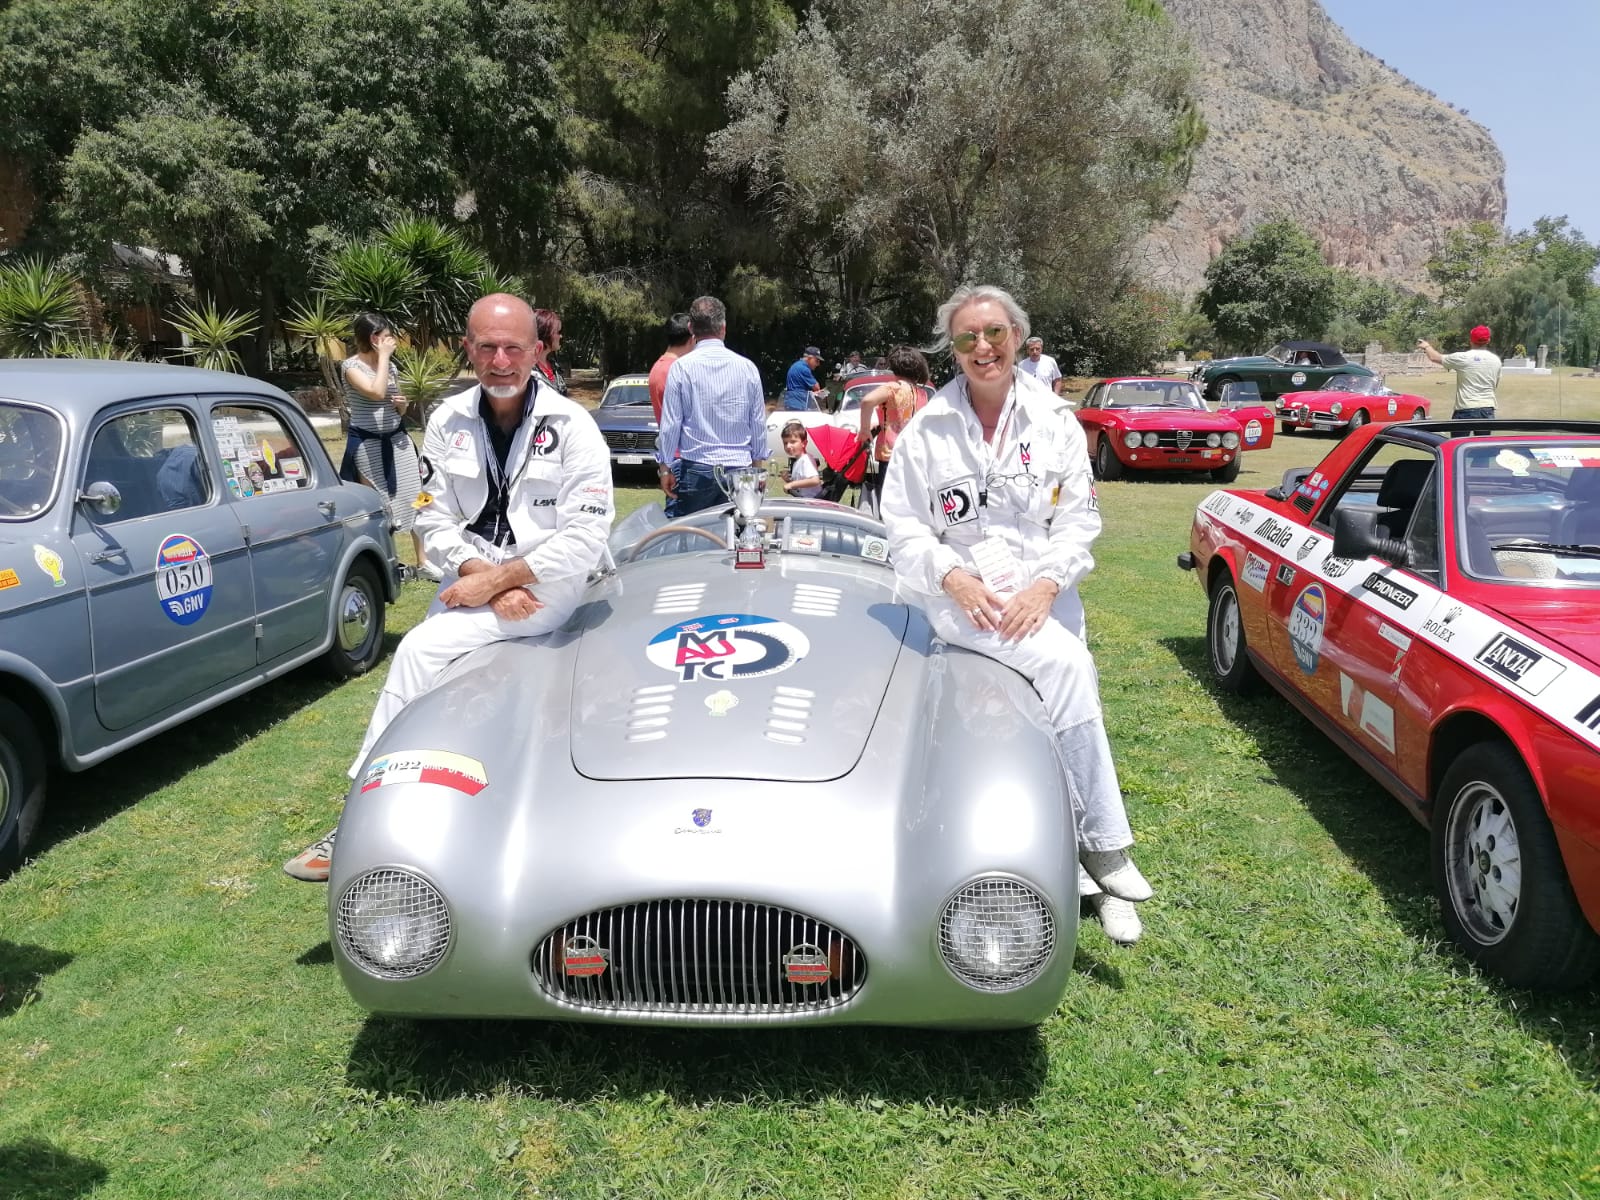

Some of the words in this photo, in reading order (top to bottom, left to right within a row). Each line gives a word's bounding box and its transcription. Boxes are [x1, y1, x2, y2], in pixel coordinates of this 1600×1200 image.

[1253, 517, 1294, 549] Alitalia
[165, 561, 204, 595] 050
[184, 593, 204, 614] GNV
[1372, 580, 1414, 607] PIONEER
[1293, 610, 1317, 650] 332
[1423, 619, 1456, 644] ROLEX
[388, 760, 421, 772] 022
